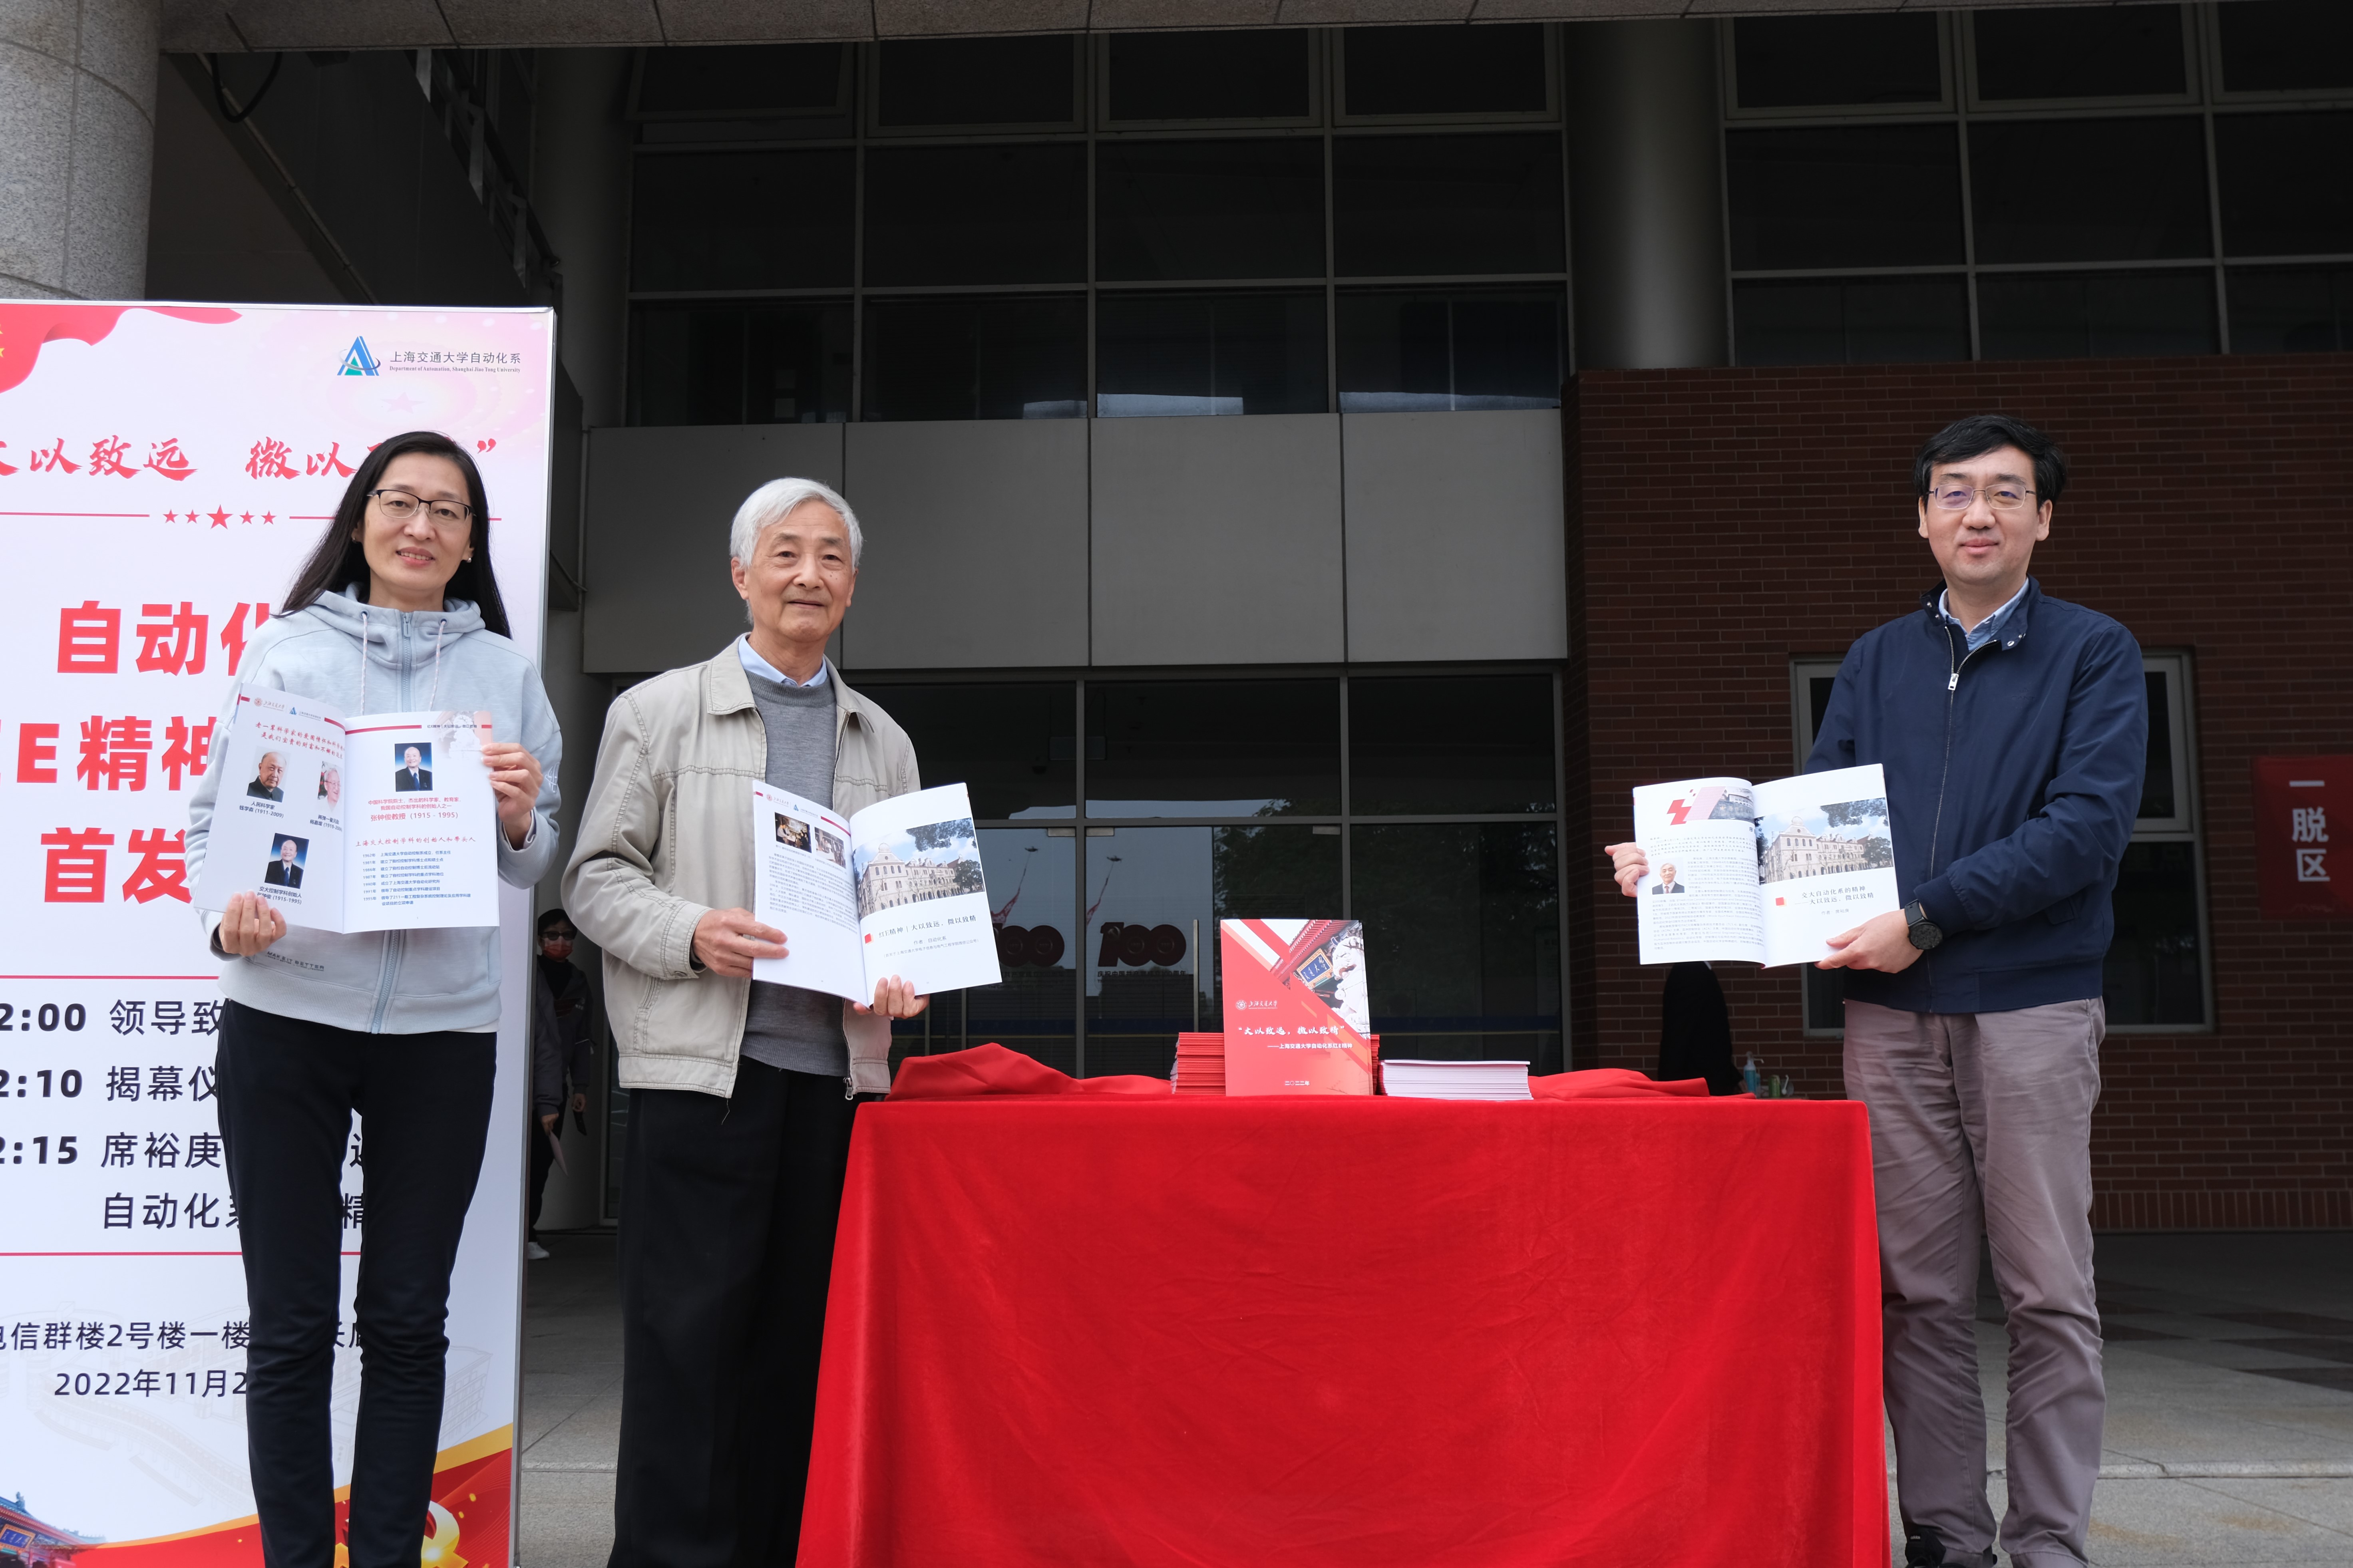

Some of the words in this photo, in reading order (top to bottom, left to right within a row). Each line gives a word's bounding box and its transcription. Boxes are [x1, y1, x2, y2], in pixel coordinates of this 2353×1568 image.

[390, 351, 521, 364] 上海交通大学自动化系
[0, 715, 217, 791] E精神
[251, 801, 275, 810] 人民科学家
[371, 813, 406, 821] 张钟俊教授
[2289, 780, 2330, 882] 一脱区
[259, 886, 302, 898] 交大控制学科创始人
[993, 923, 1064, 967] 00
[267, 951, 286, 960] MAKE
[295, 960, 324, 969] BETTER
[109, 999, 224, 1035] 领导致
[0, 1136, 78, 1165] :15
[101, 1132, 222, 1168] 席裕庚
[0, 1321, 249, 1350] 信群楼2号楼一楼
